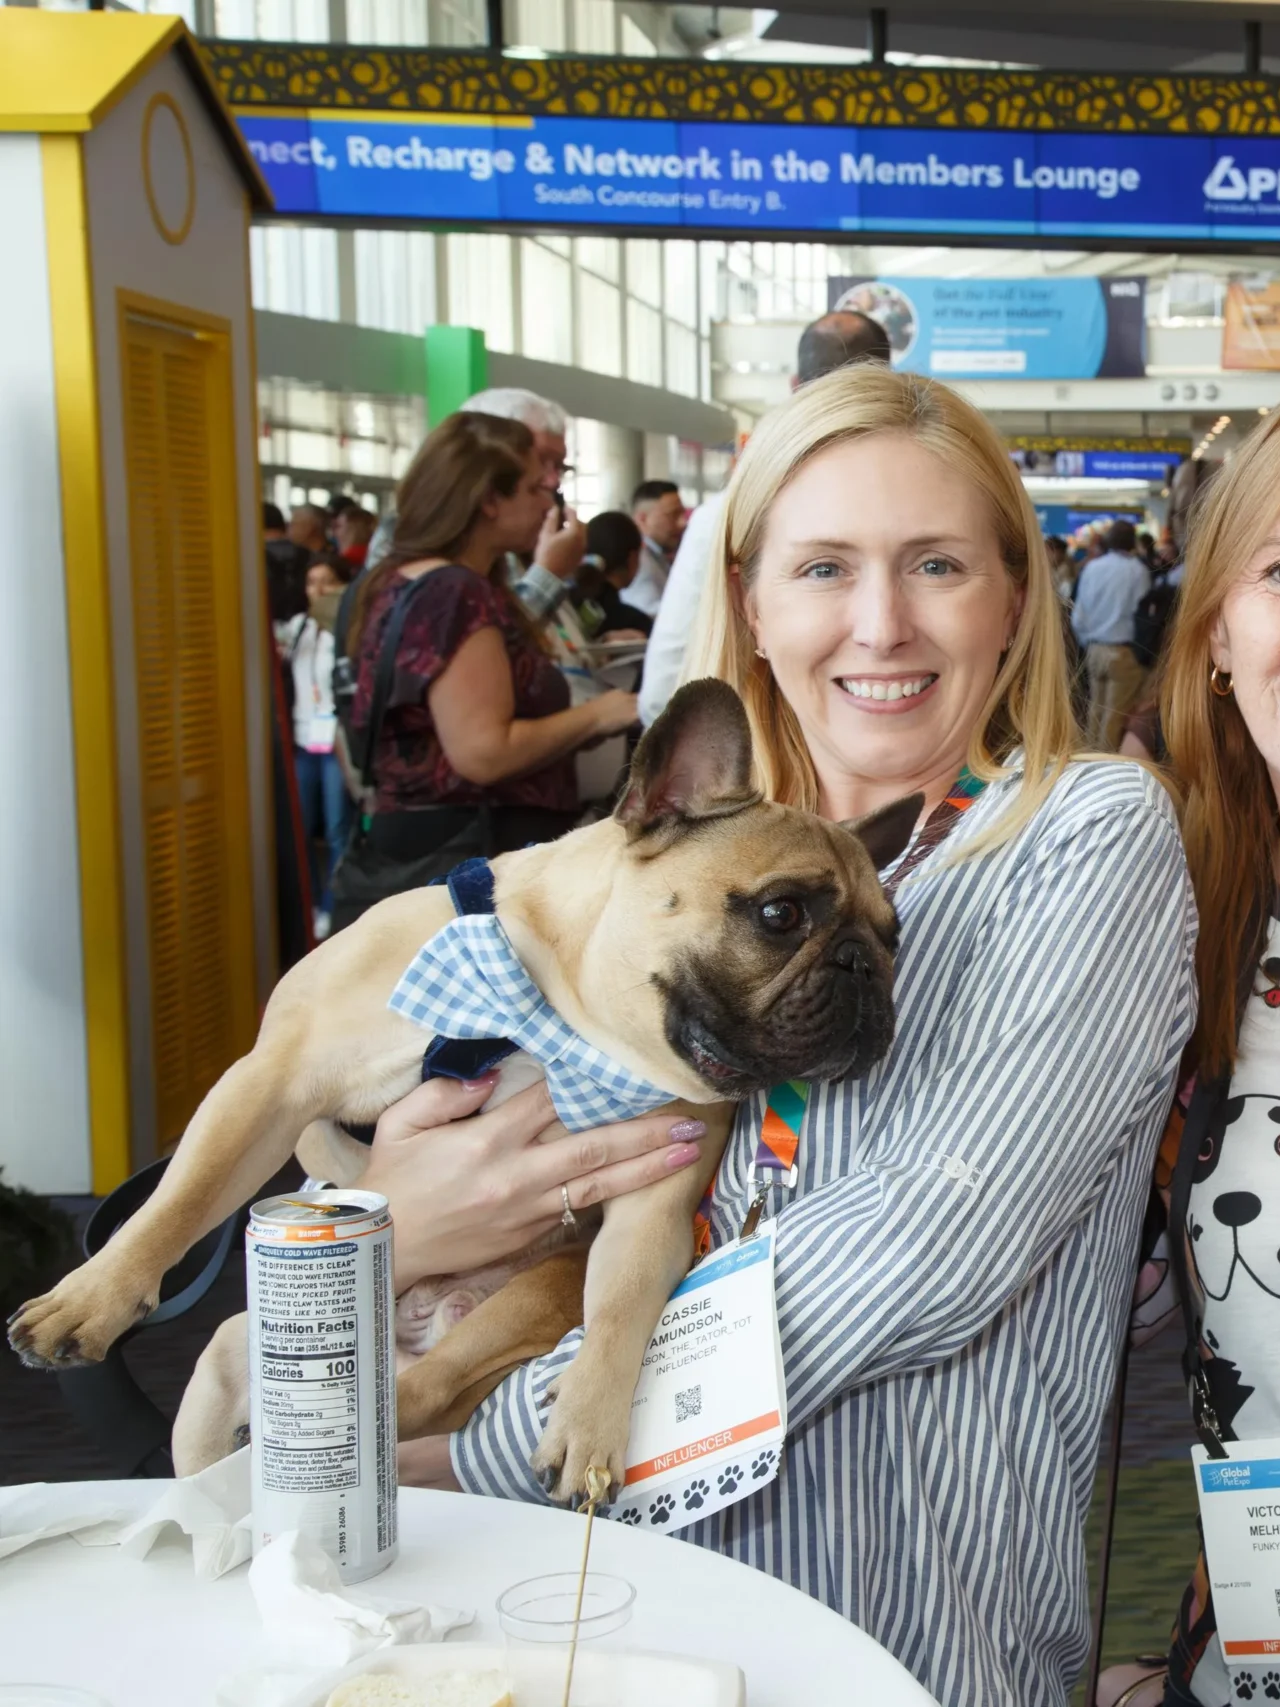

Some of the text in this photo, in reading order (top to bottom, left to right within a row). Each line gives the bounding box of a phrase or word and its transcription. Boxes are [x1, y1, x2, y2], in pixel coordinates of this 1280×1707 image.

[348, 136, 515, 182] Recharge
[526, 142, 556, 176] &
[565, 143, 722, 180] Network
[731, 148, 763, 180] in
[773, 151, 830, 183] the
[841, 153, 1004, 189] Members
[1014, 158, 1141, 198] Lounge
[535, 182, 593, 206] South
[598, 185, 704, 210] Concourse
[708, 189, 761, 214] Entry
[284, 1248, 300, 1256] COLD
[303, 1248, 322, 1256] WAVE
[258, 1260, 267, 1268] THE
[269, 1262, 313, 1270] DIFFERENCE
[316, 1262, 324, 1270] IS
[268, 1272, 286, 1280] UNIQUE
[323, 1270, 355, 1278] FILTRATION
[338, 1278, 356, 1286] TASTE
[342, 1296, 356, 1304] AND
[259, 1306, 290, 1315] REFRESHES
[332, 1306, 356, 1314] OTHER.
[661, 1297, 712, 1326] CASSIE
[261, 1319, 354, 1333] Nutrition Facts
[649, 1311, 723, 1350] AMUNDSON
[656, 1345, 718, 1376] INFLUENCER
[262, 1360, 355, 1378] Calories 100
[263, 1398, 280, 1407] Sodium
[277, 1418, 294, 1427] Sugars
[653, 1431, 733, 1472] INFLUENCER
[1220, 1466, 1250, 1477] Global
[1253, 1542, 1280, 1552] FUNKY
